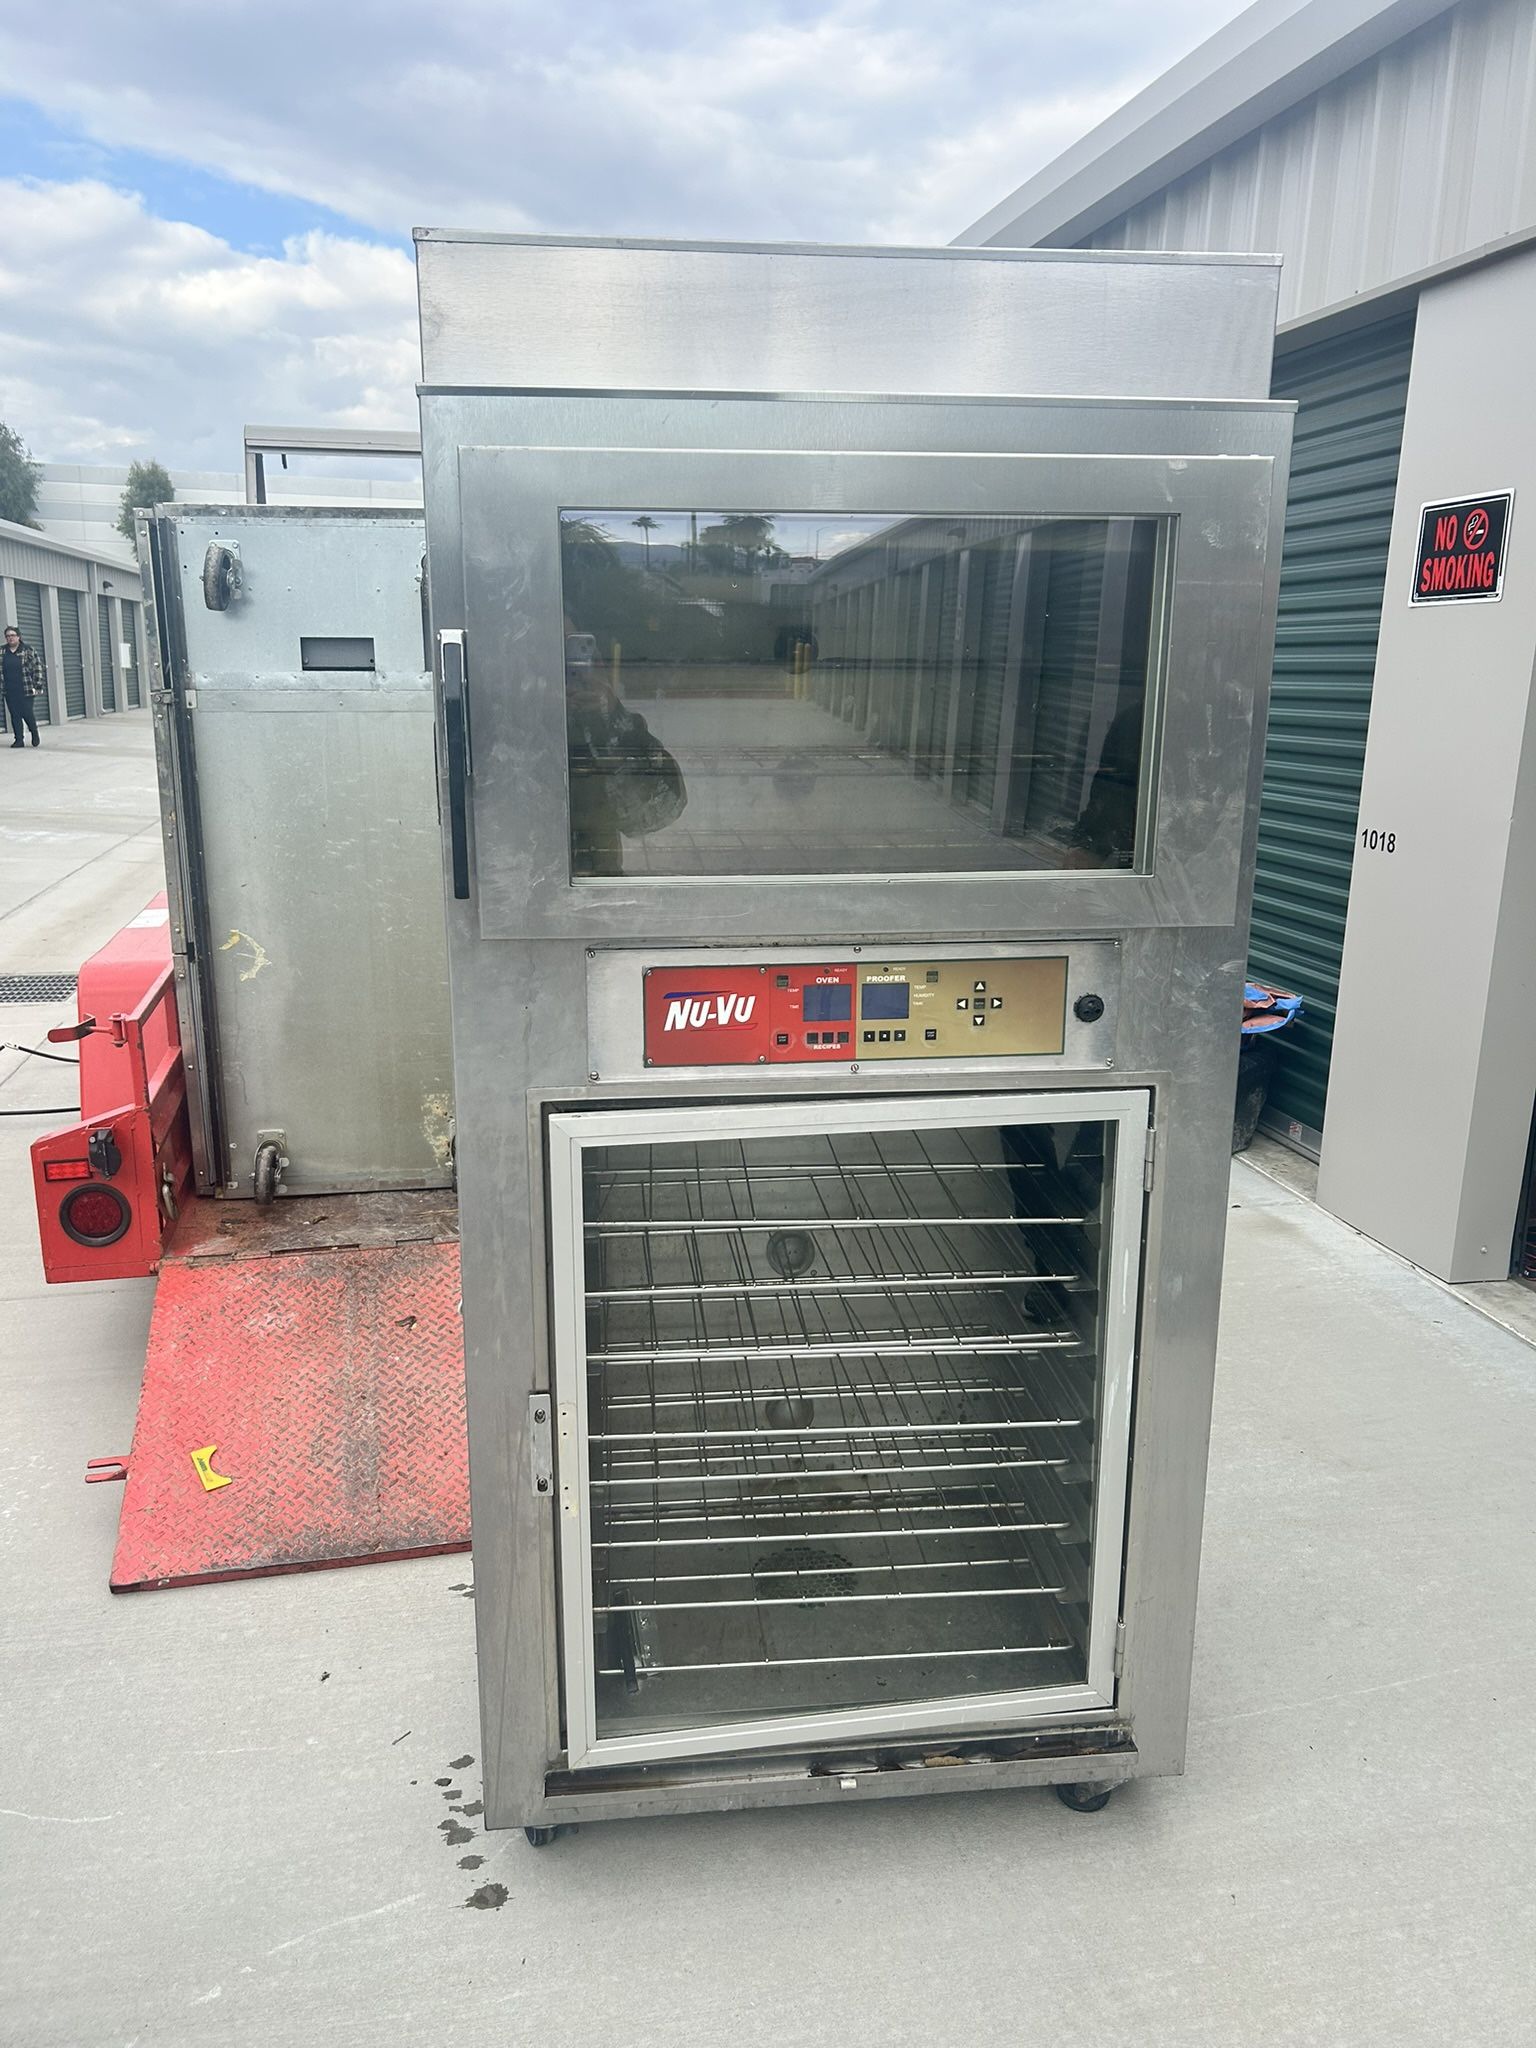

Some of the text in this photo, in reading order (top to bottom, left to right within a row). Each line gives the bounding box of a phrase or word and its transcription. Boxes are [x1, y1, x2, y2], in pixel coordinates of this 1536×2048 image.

[1434, 514, 1458, 551] NO
[1420, 551, 1495, 592] SMOKING
[1361, 828, 1396, 853] 1018
